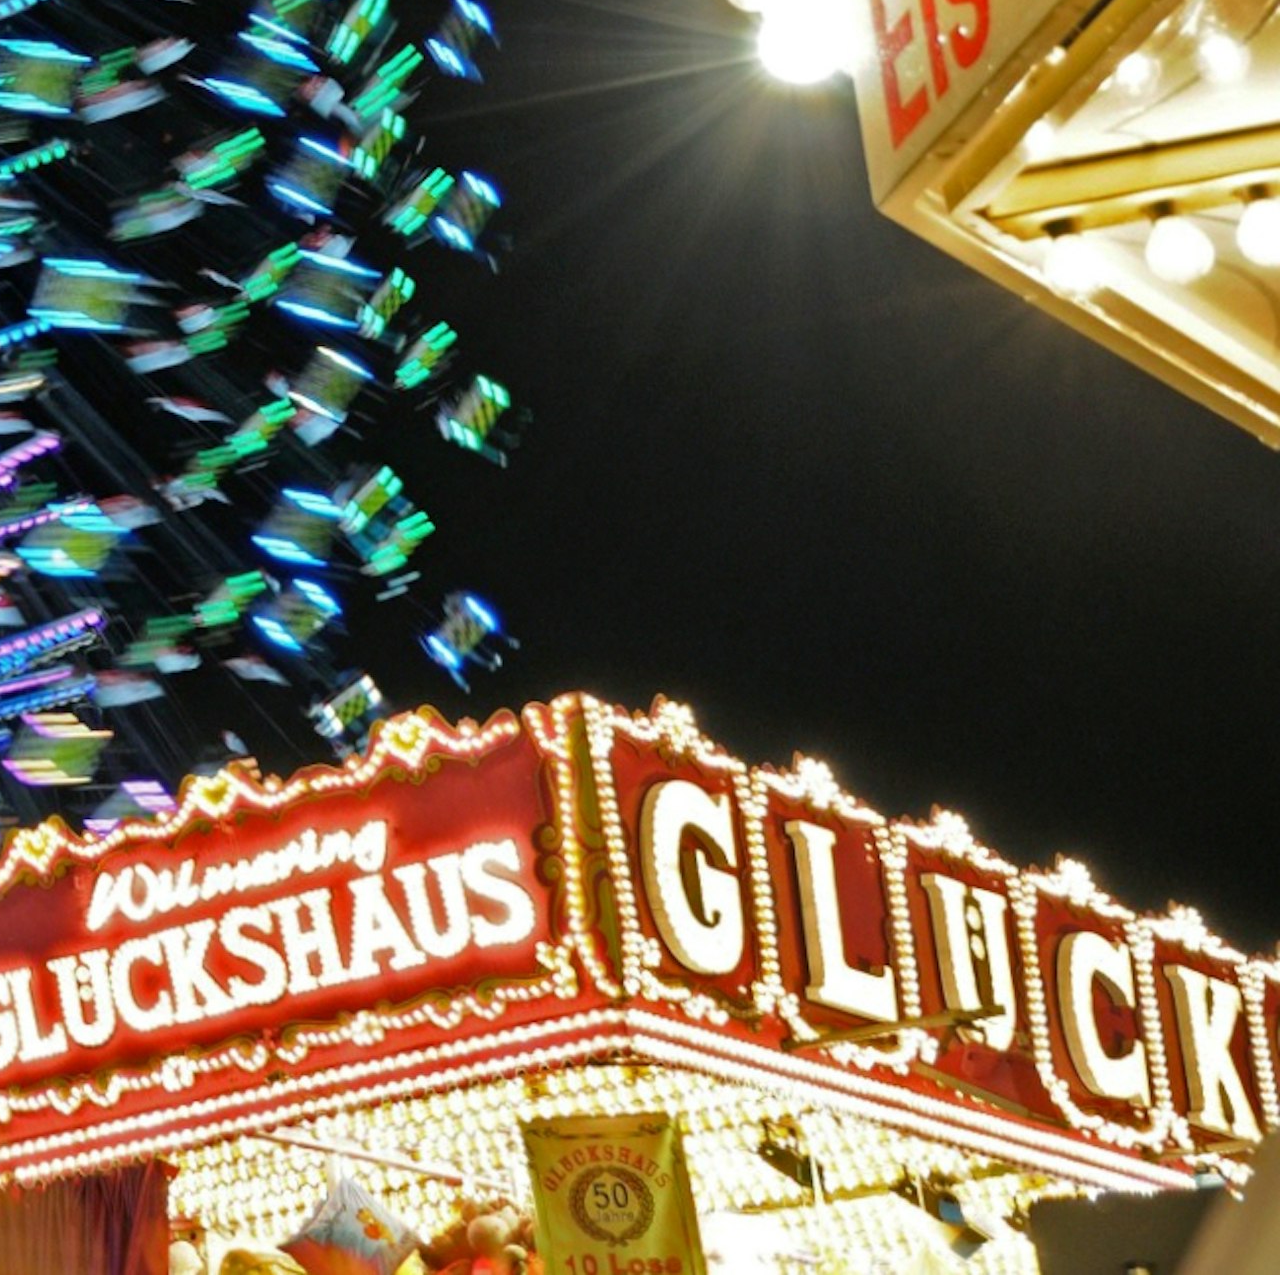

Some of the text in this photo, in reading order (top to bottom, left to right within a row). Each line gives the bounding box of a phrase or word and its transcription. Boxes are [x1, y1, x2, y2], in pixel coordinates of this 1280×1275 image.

[592, 1182, 630, 1210] 50
[595, 1210, 635, 1223] Jahre
[565, 1254, 598, 1275] 10
